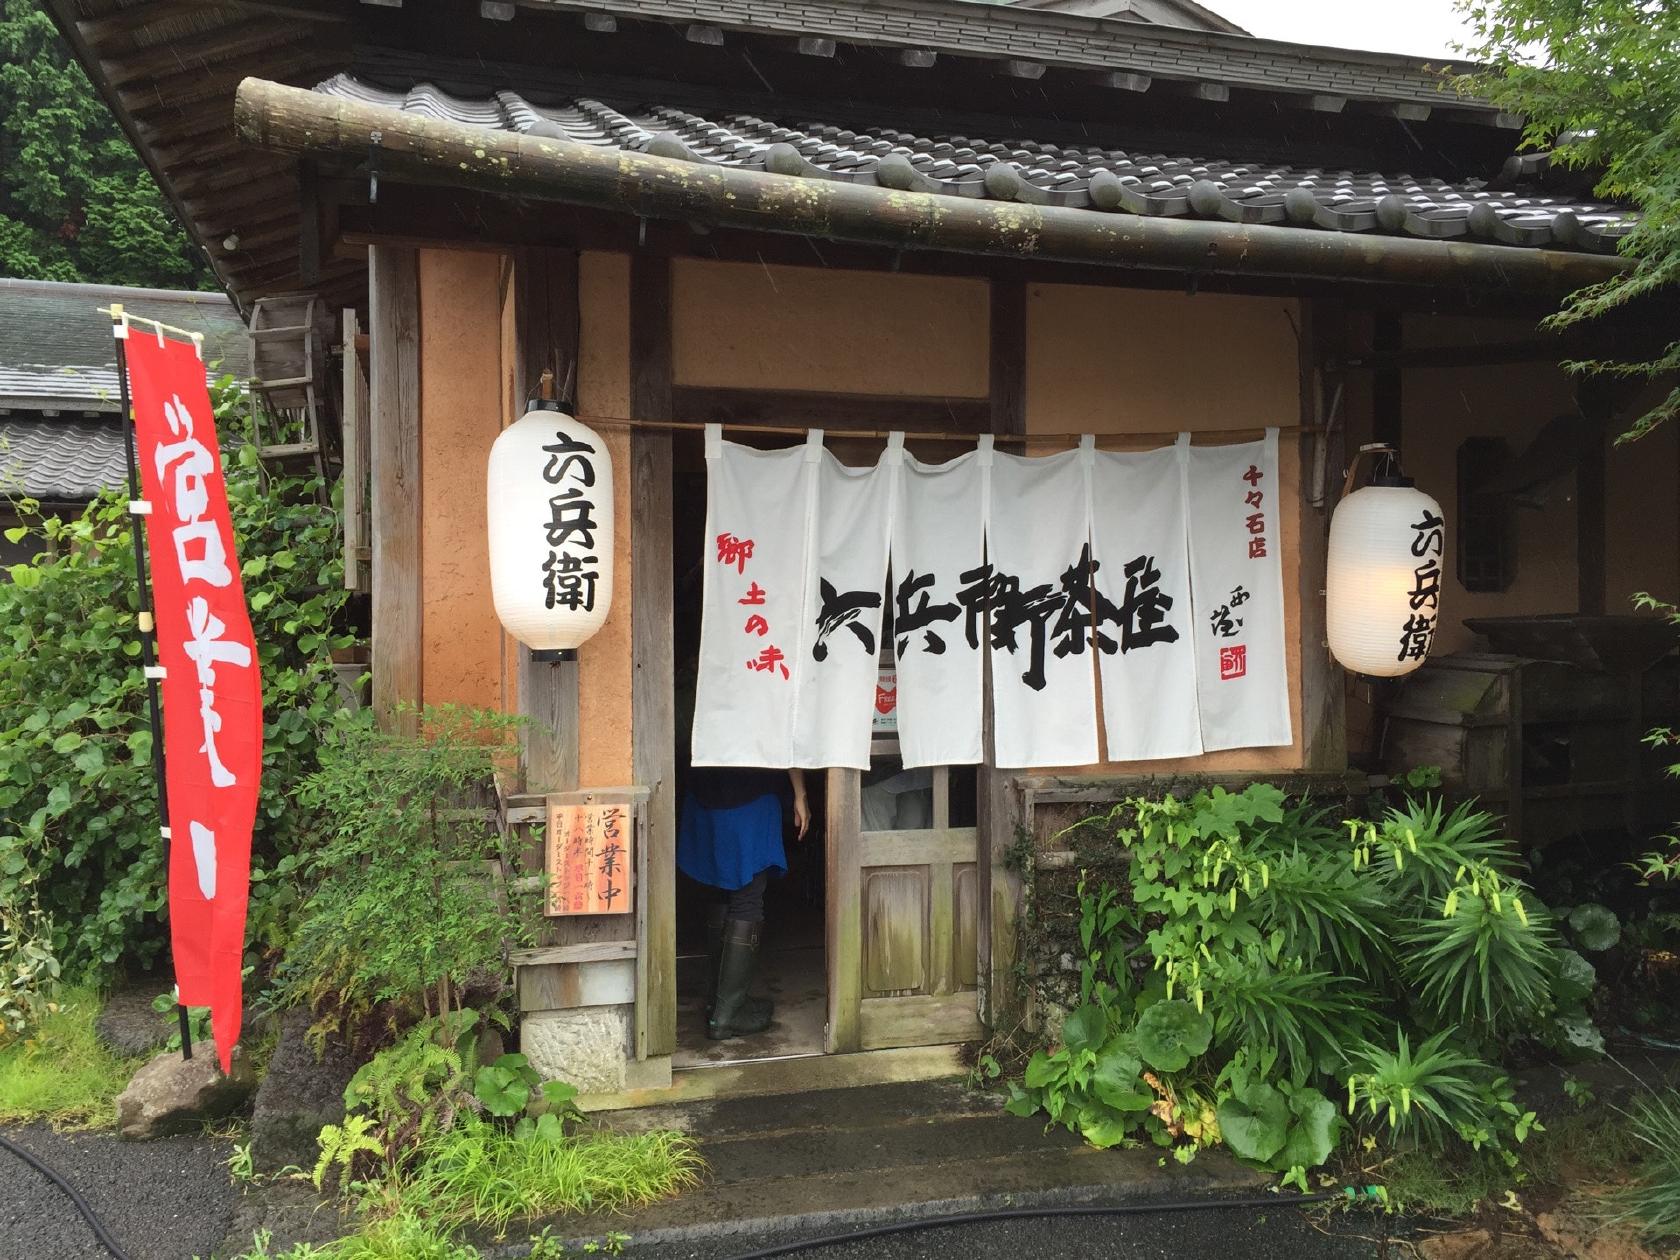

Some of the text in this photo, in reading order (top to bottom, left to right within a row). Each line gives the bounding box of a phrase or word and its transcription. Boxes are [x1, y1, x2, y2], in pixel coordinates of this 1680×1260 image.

[541, 431, 599, 612] 六兵衛
[1398, 509, 1445, 662] 六兵衛
[716, 532, 790, 680] 郷土の味
[812, 542, 1180, 692] 六兵衛茶屋
[595, 808, 627, 912] 営業中
